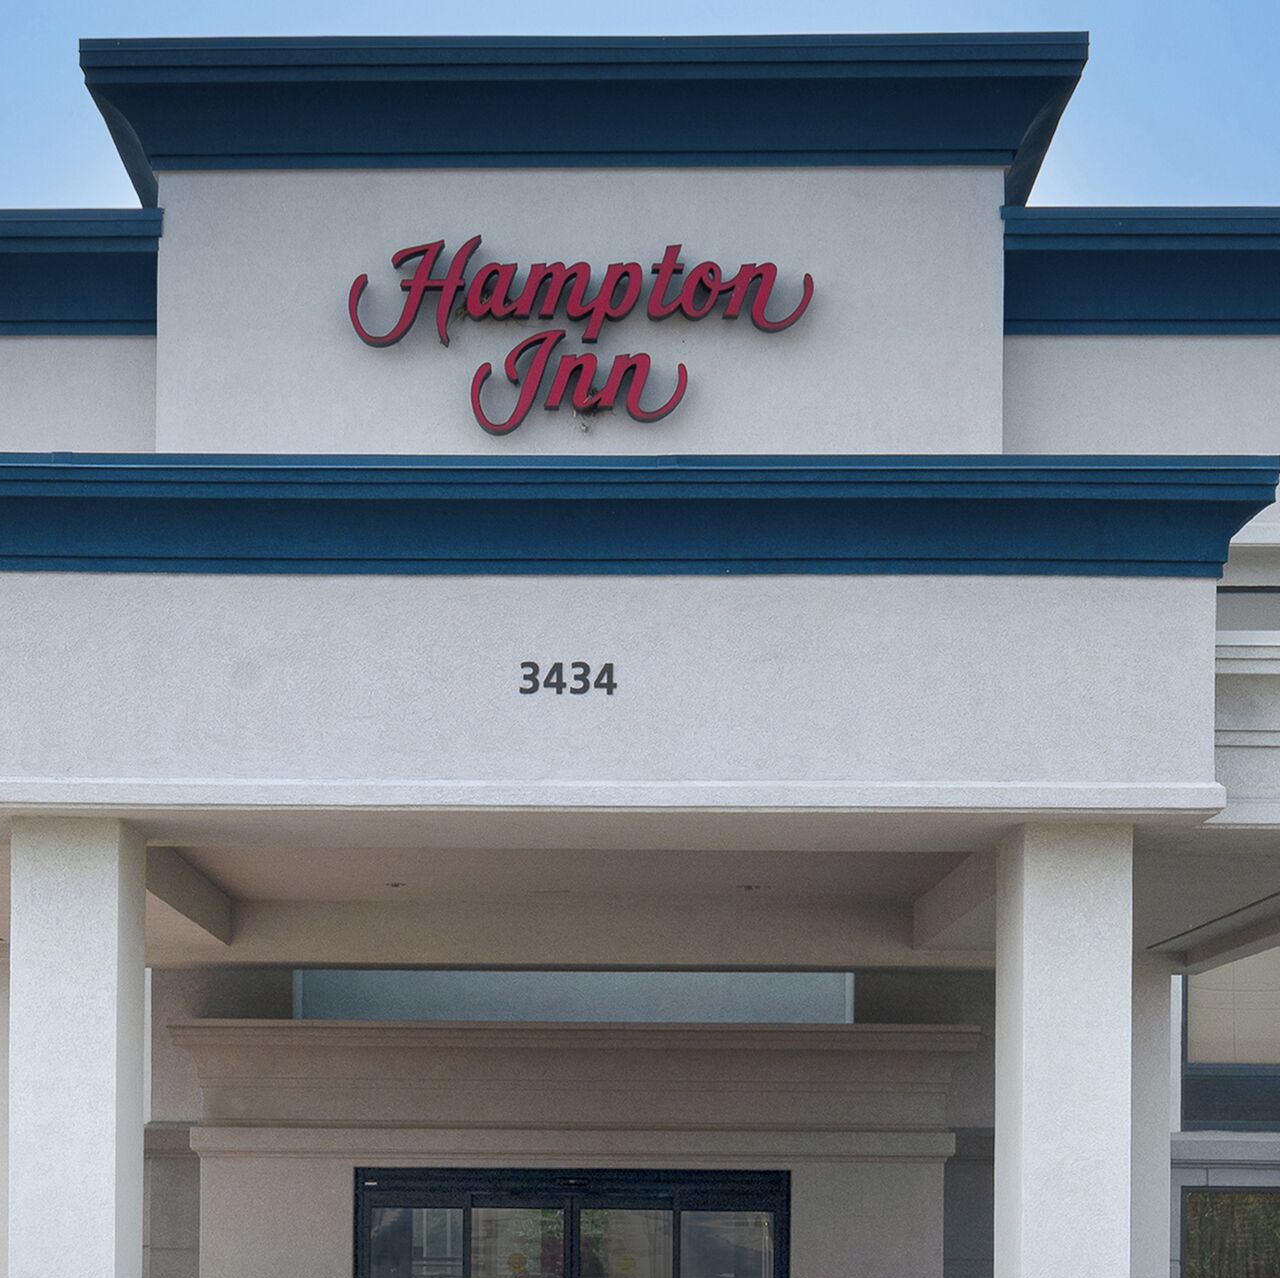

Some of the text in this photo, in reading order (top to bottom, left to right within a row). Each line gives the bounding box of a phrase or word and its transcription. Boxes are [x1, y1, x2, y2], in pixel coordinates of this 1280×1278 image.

[349, 234, 814, 348] Hampton
[470, 329, 688, 436] Inn
[519, 661, 618, 696] 3434
